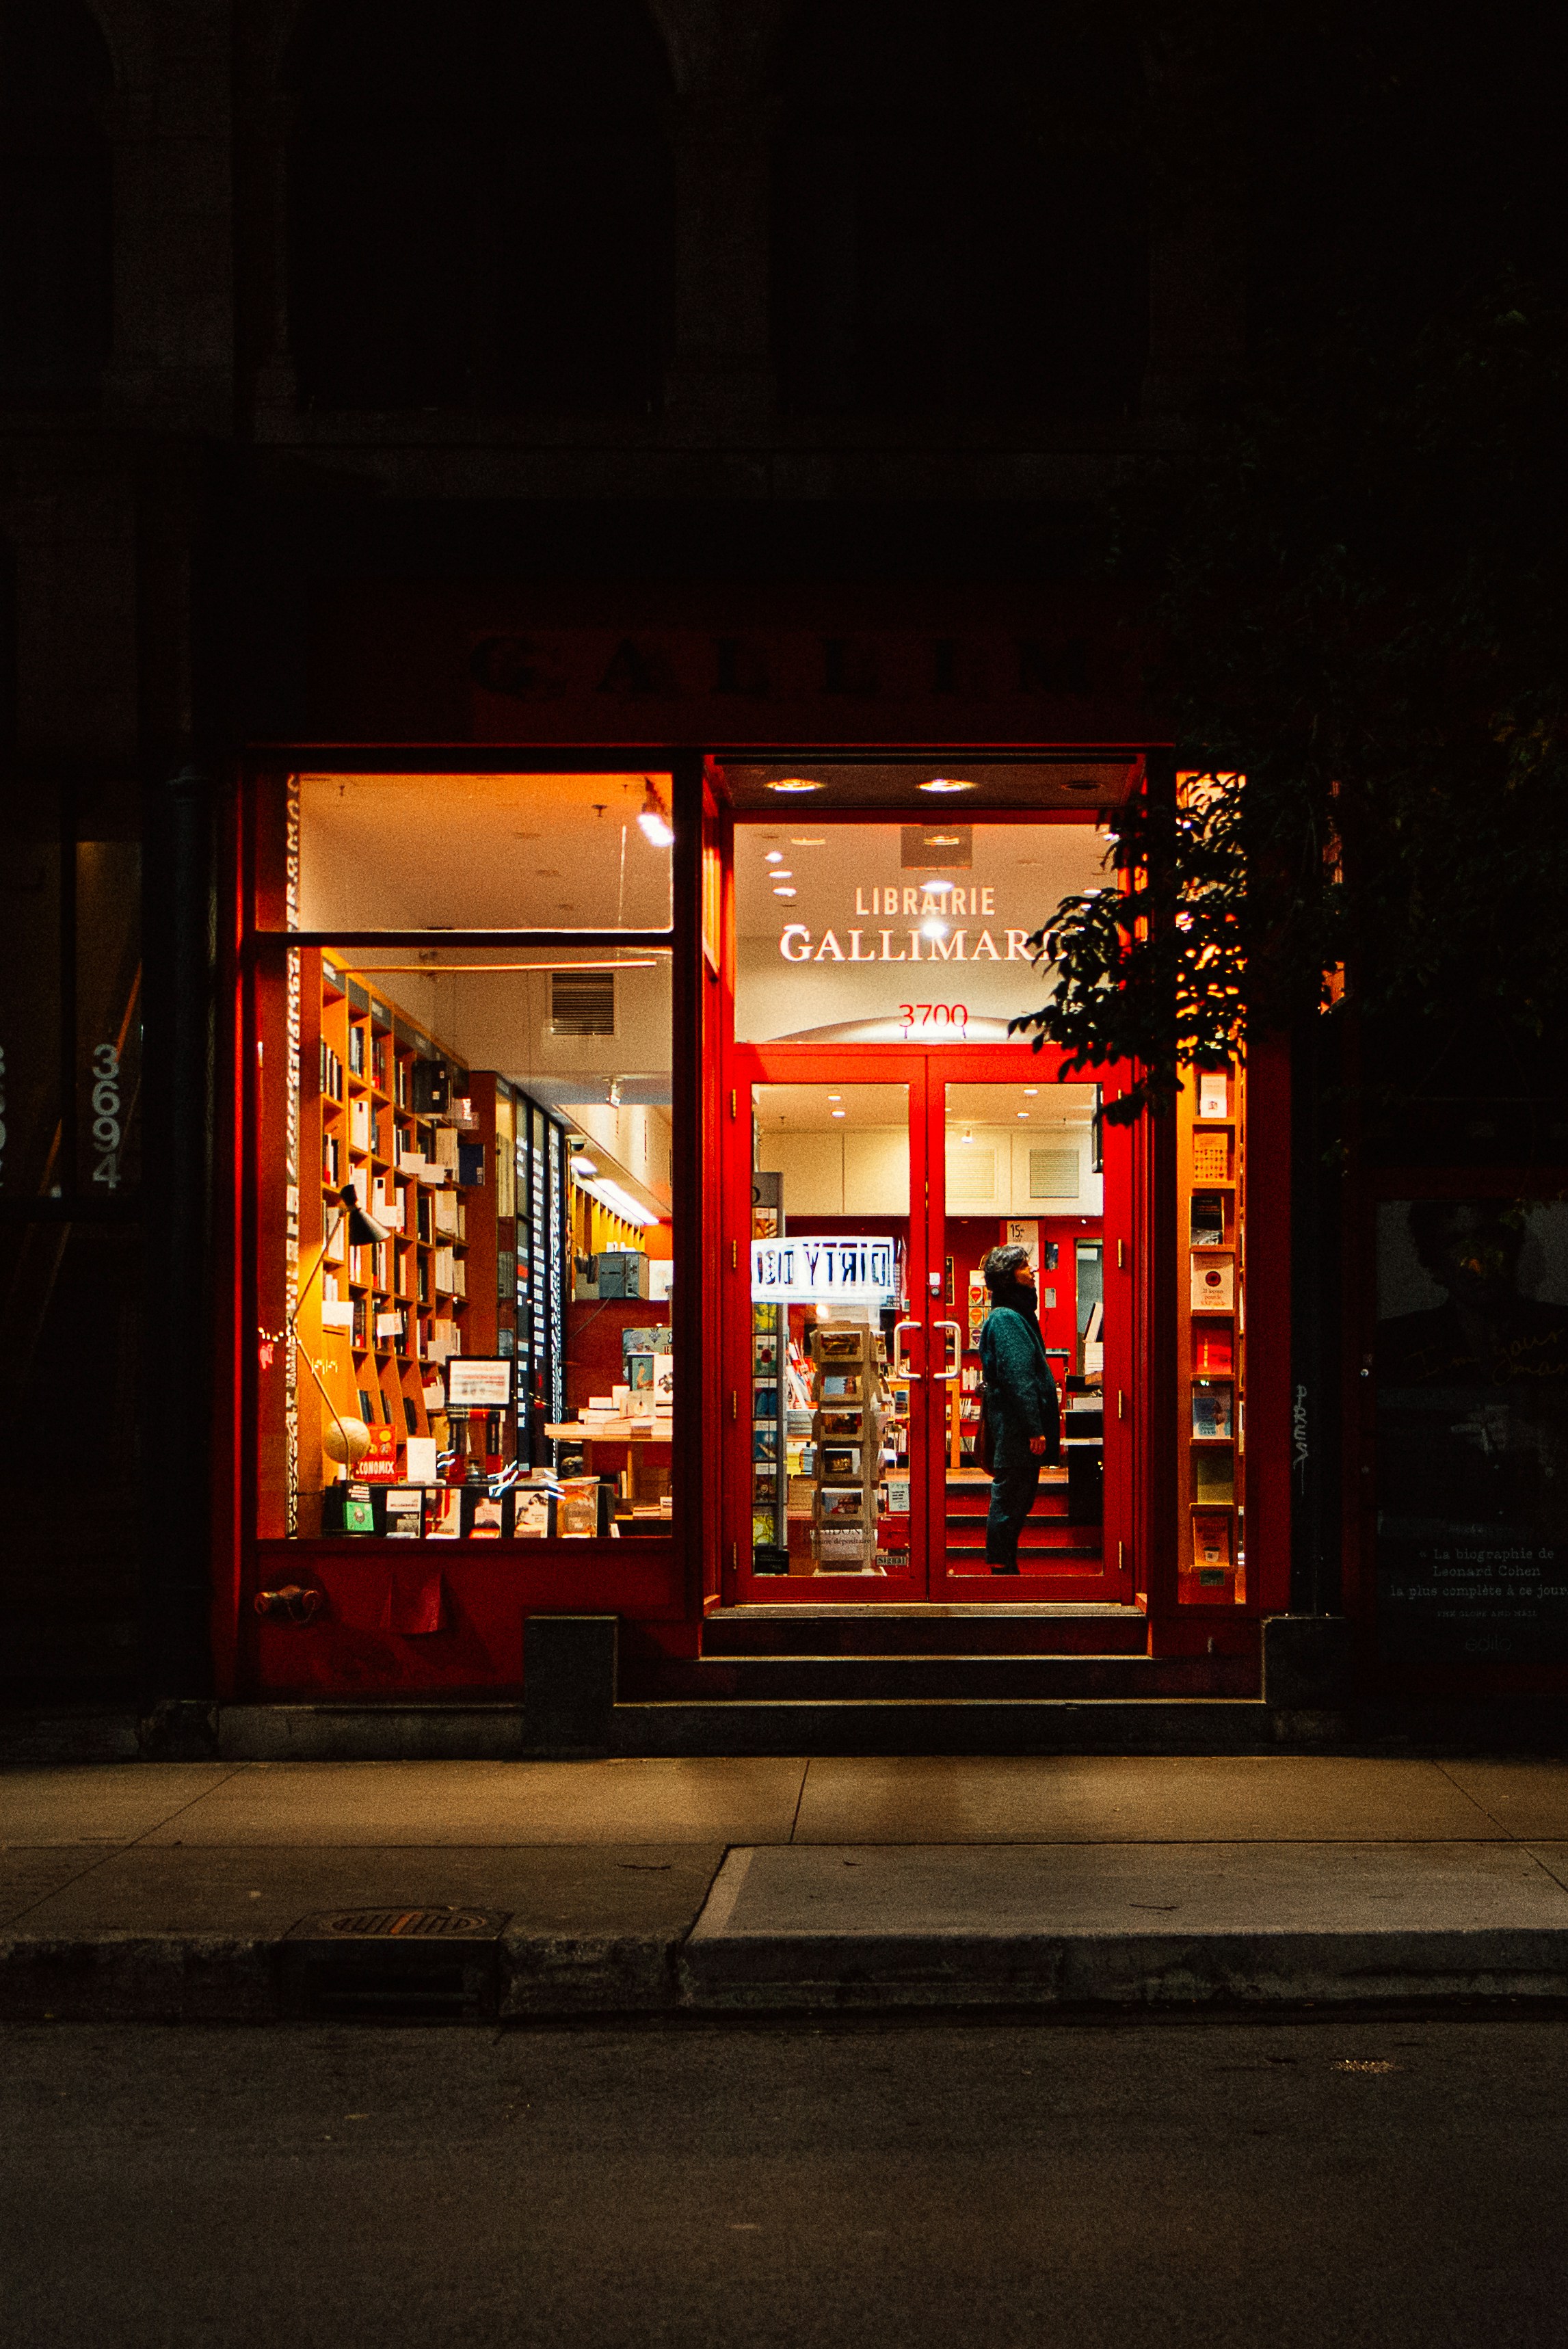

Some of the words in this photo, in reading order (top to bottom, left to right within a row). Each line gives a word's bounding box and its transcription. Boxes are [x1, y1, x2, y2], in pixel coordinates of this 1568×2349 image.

[855, 887, 995, 916] LIBRAIRIE
[898, 1003, 968, 1028] 3700
[91, 1043, 122, 1189] 3694
[356, 1460, 395, 1475] CONOMIX
[1433, 1548, 1450, 1559] La
[1455, 1548, 1533, 1562] biographie
[1539, 1548, 1554, 1559] de
[1433, 1565, 1493, 1577] Leonard
[1498, 1565, 1541, 1577] Cohen
[1390, 1584, 1404, 1596] la
[1409, 1584, 1437, 1599] plus
[1442, 1584, 1502, 1599] complète
[1506, 1584, 1515, 1596] à
[1519, 1587, 1532, 1596] ce
